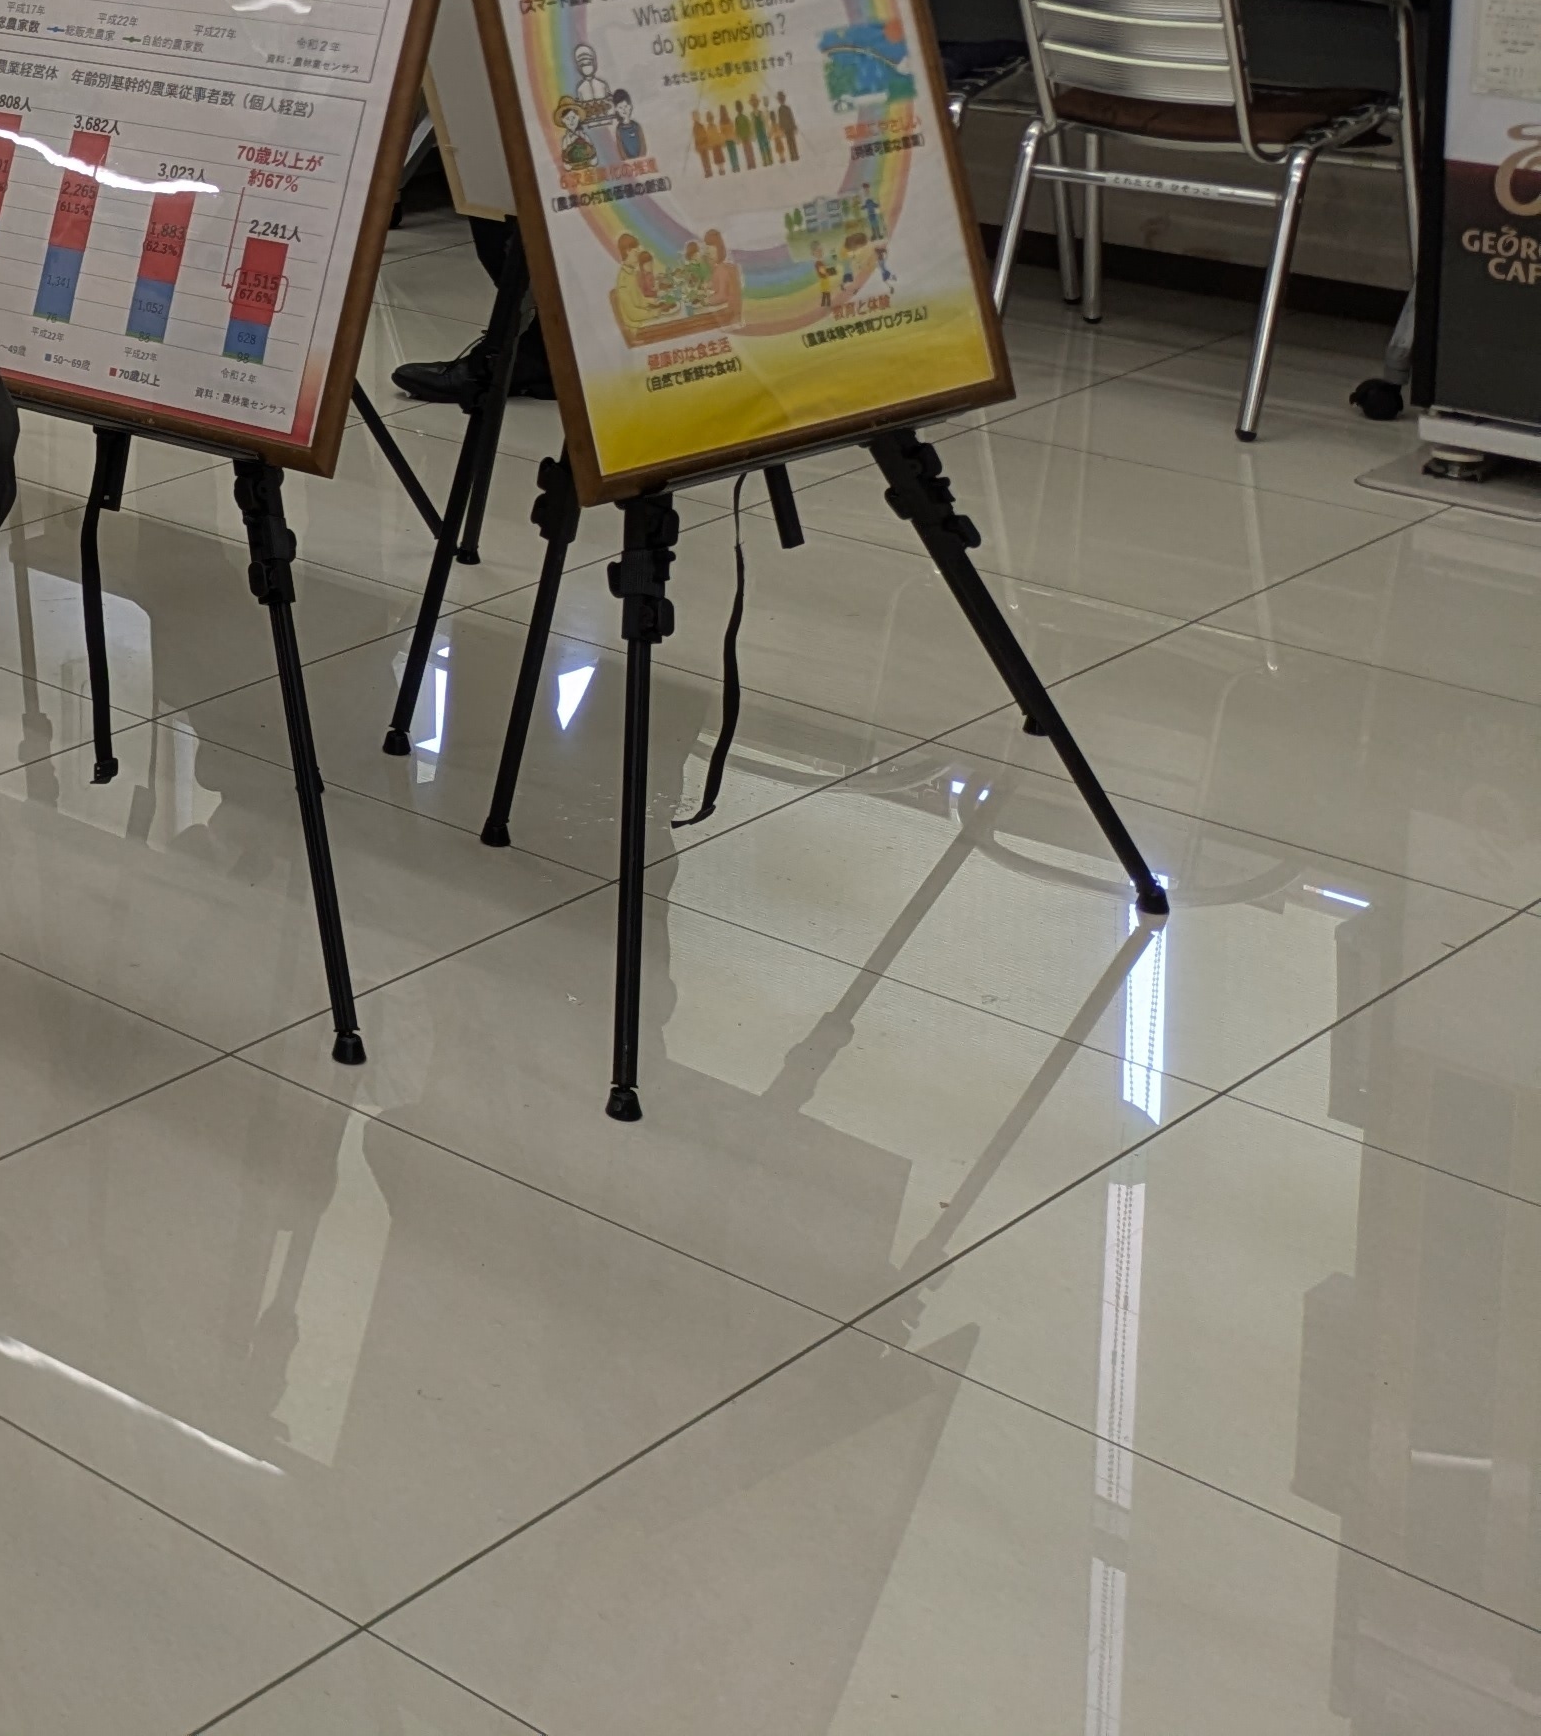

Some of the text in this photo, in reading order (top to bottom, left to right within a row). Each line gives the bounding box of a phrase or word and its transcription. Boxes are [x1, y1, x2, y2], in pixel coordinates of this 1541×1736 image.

[633, 2, 678, 28] What
[652, 19, 774, 58] do you envision
[237, 145, 325, 173] 70歳以上が
[247, 168, 299, 193] 約67%
[248, 219, 302, 243] 2,241人
[1461, 224, 1541, 261] GEOR
